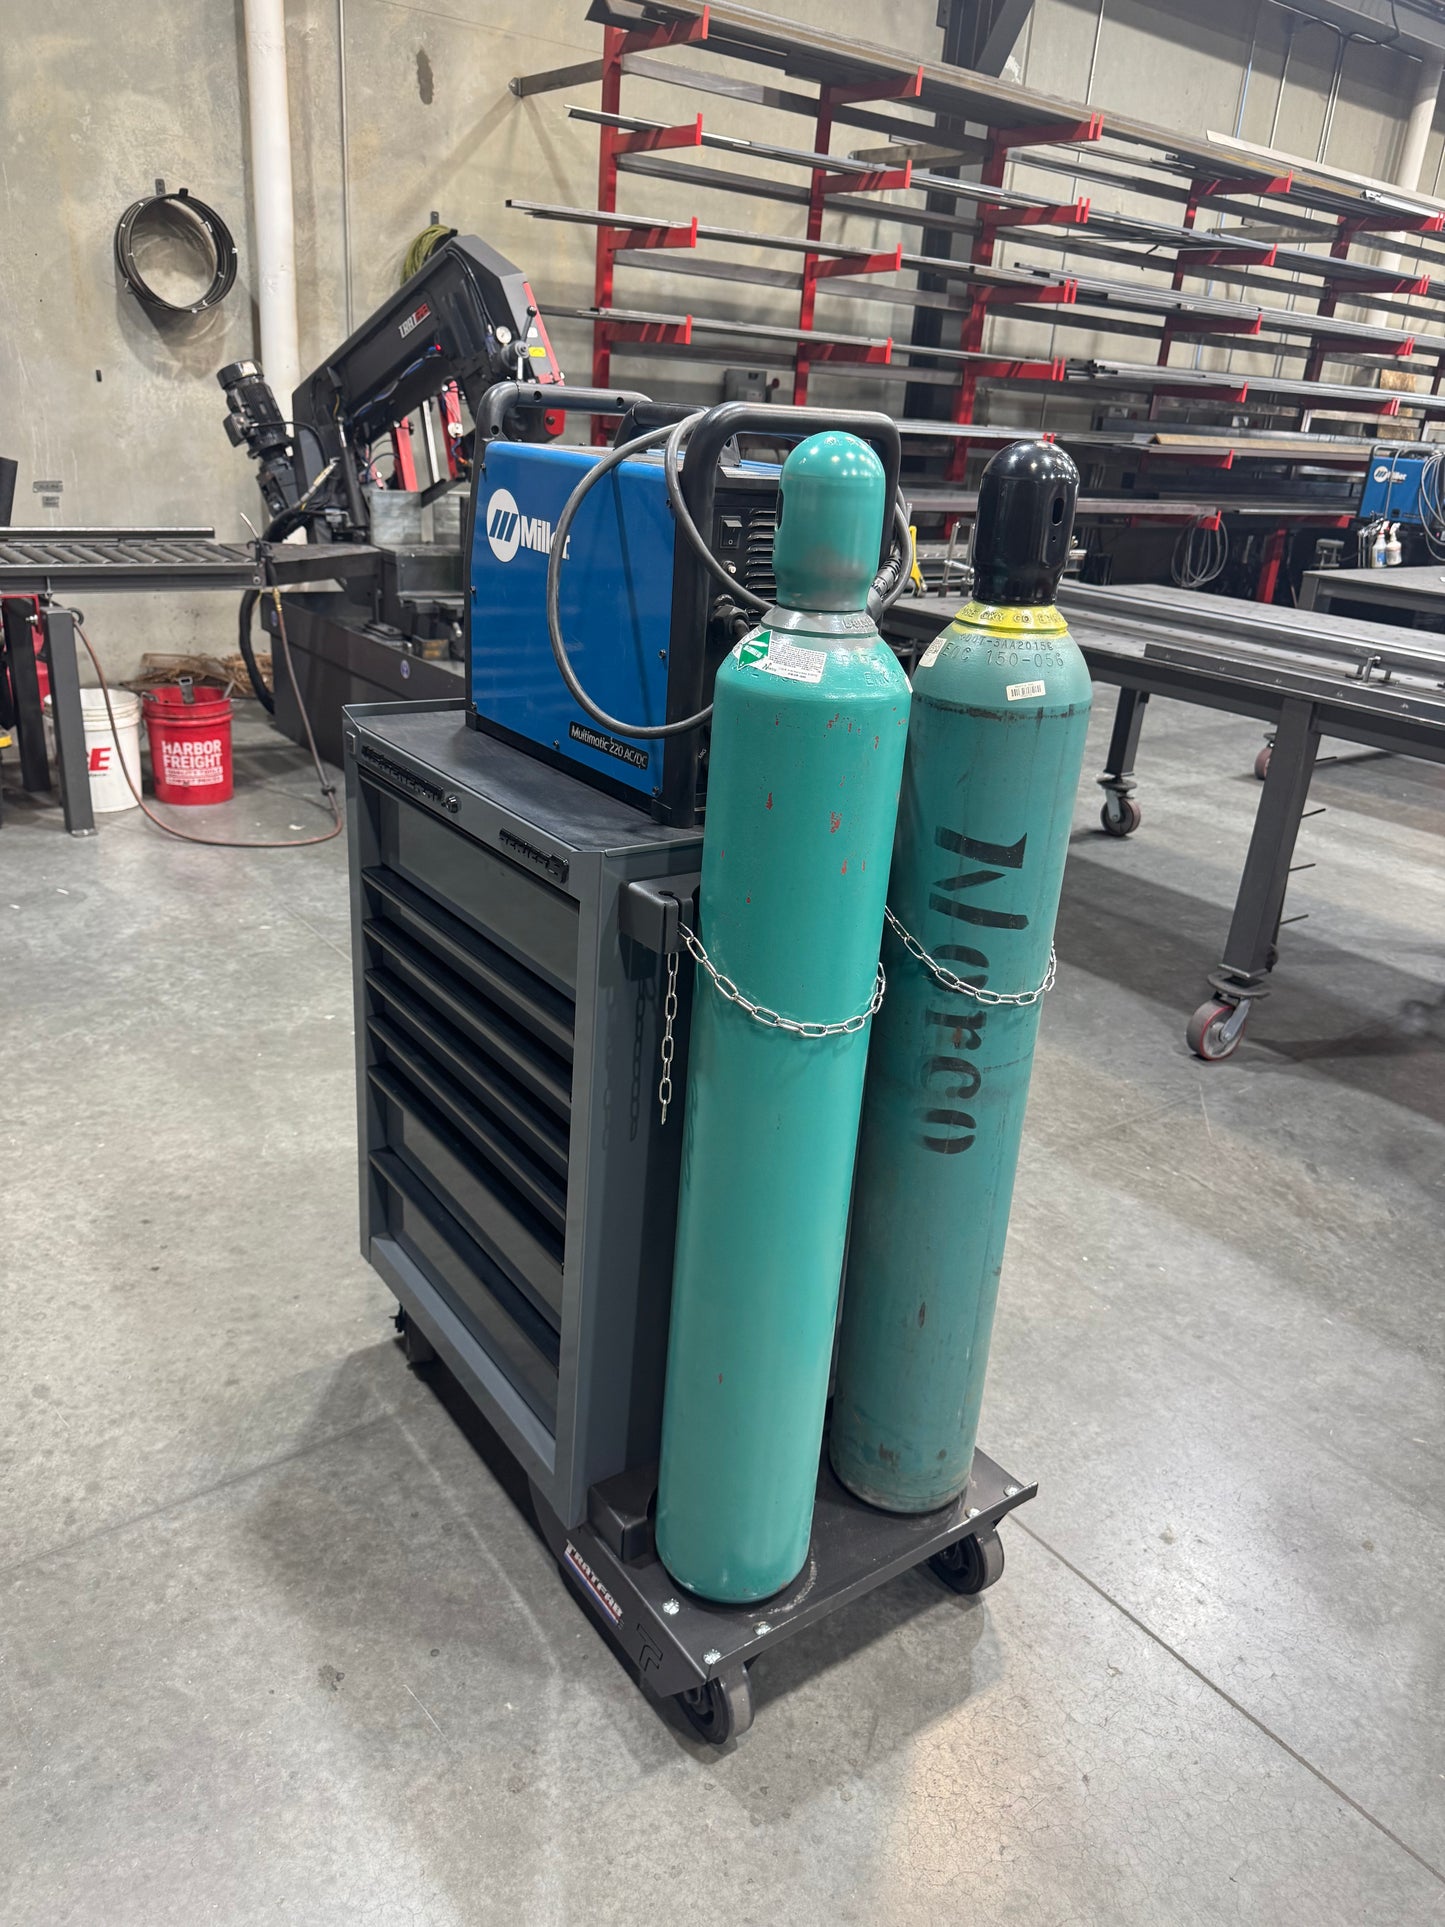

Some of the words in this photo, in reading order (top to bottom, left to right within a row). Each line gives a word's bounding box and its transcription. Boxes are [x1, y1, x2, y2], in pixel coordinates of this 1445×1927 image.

[161, 739, 221, 756] HARBOR
[608, 742, 624, 757] 220
[623, 748, 648, 767] AC/DC
[163, 753, 222, 769] FREIGHT
